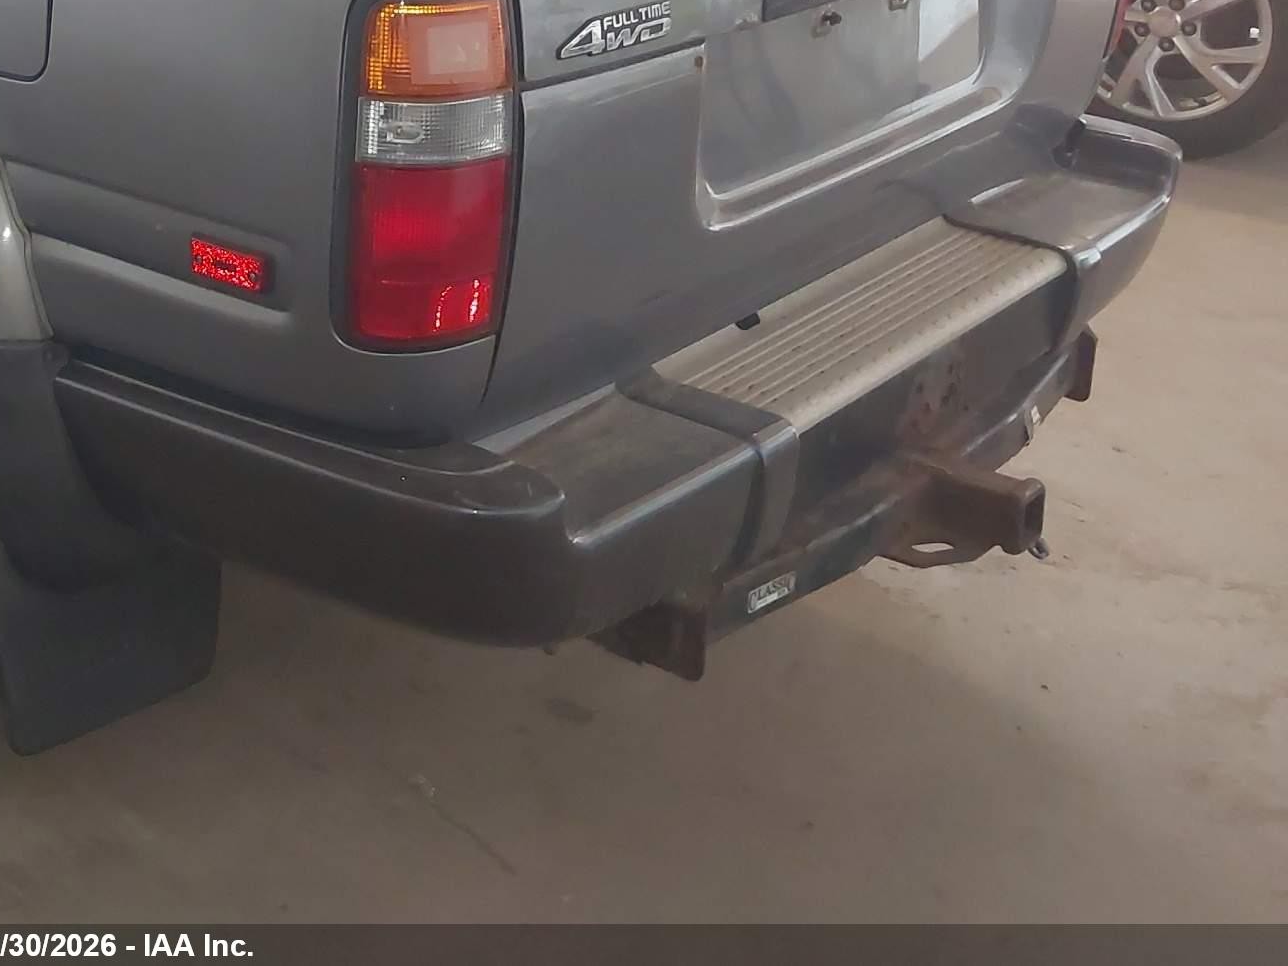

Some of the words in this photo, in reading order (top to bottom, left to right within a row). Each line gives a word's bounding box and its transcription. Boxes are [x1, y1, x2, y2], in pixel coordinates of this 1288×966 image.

[603, 11, 639, 30] FULL
[638, 1, 672, 21] TIME
[560, 18, 672, 58] 4WD
